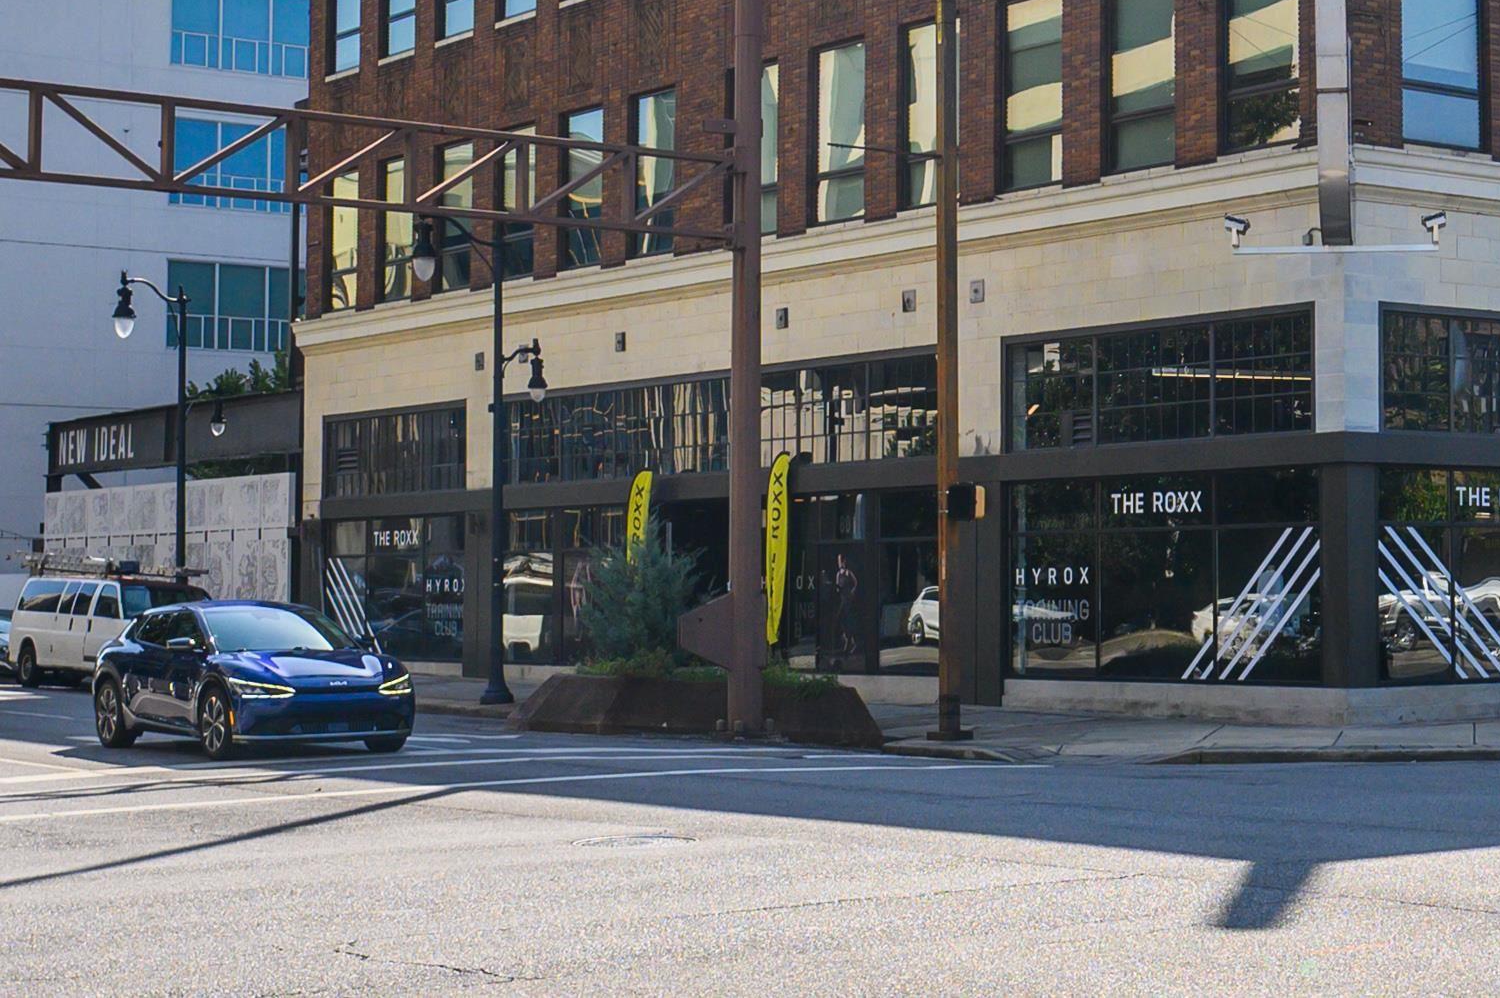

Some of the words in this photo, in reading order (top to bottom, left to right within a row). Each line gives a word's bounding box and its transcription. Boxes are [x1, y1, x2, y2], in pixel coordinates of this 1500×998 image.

[59, 429, 87, 466] NEW
[94, 424, 134, 462] IDEAL
[1111, 493, 1144, 514] THE
[1152, 491, 1202, 513] ROXX
[1456, 487, 1490, 507] THE
[632, 485, 644, 546] ROXX
[374, 531, 390, 546] THE
[394, 530, 419, 545] ROXX
[1015, 567, 1089, 585] HYROX
[426, 603, 464, 619] TRAININ
[434, 621, 457, 636] CLUB
[1032, 623, 1072, 643] CLUB
